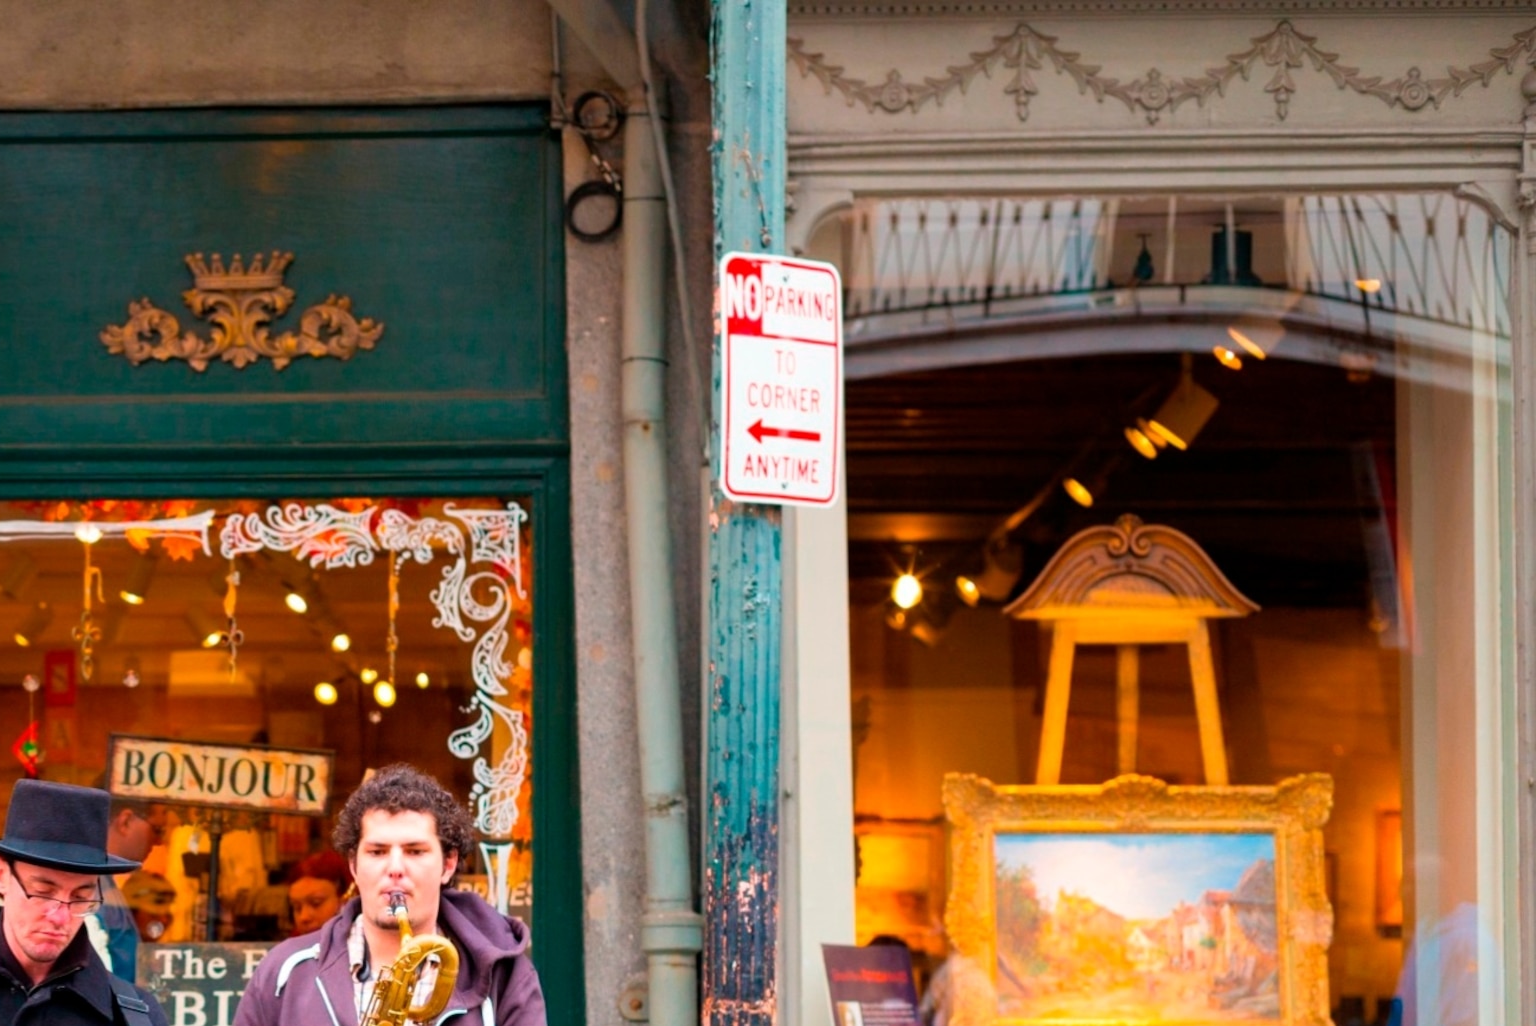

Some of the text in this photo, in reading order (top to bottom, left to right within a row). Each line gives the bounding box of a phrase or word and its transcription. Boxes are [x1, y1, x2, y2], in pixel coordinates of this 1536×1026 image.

[727, 274, 834, 322] NO PARKING
[775, 350, 797, 376] TO
[747, 382, 821, 413] CORNER
[743, 454, 820, 484] ANYTIME
[120, 749, 318, 802] BONJOUR
[155, 949, 228, 980] The
